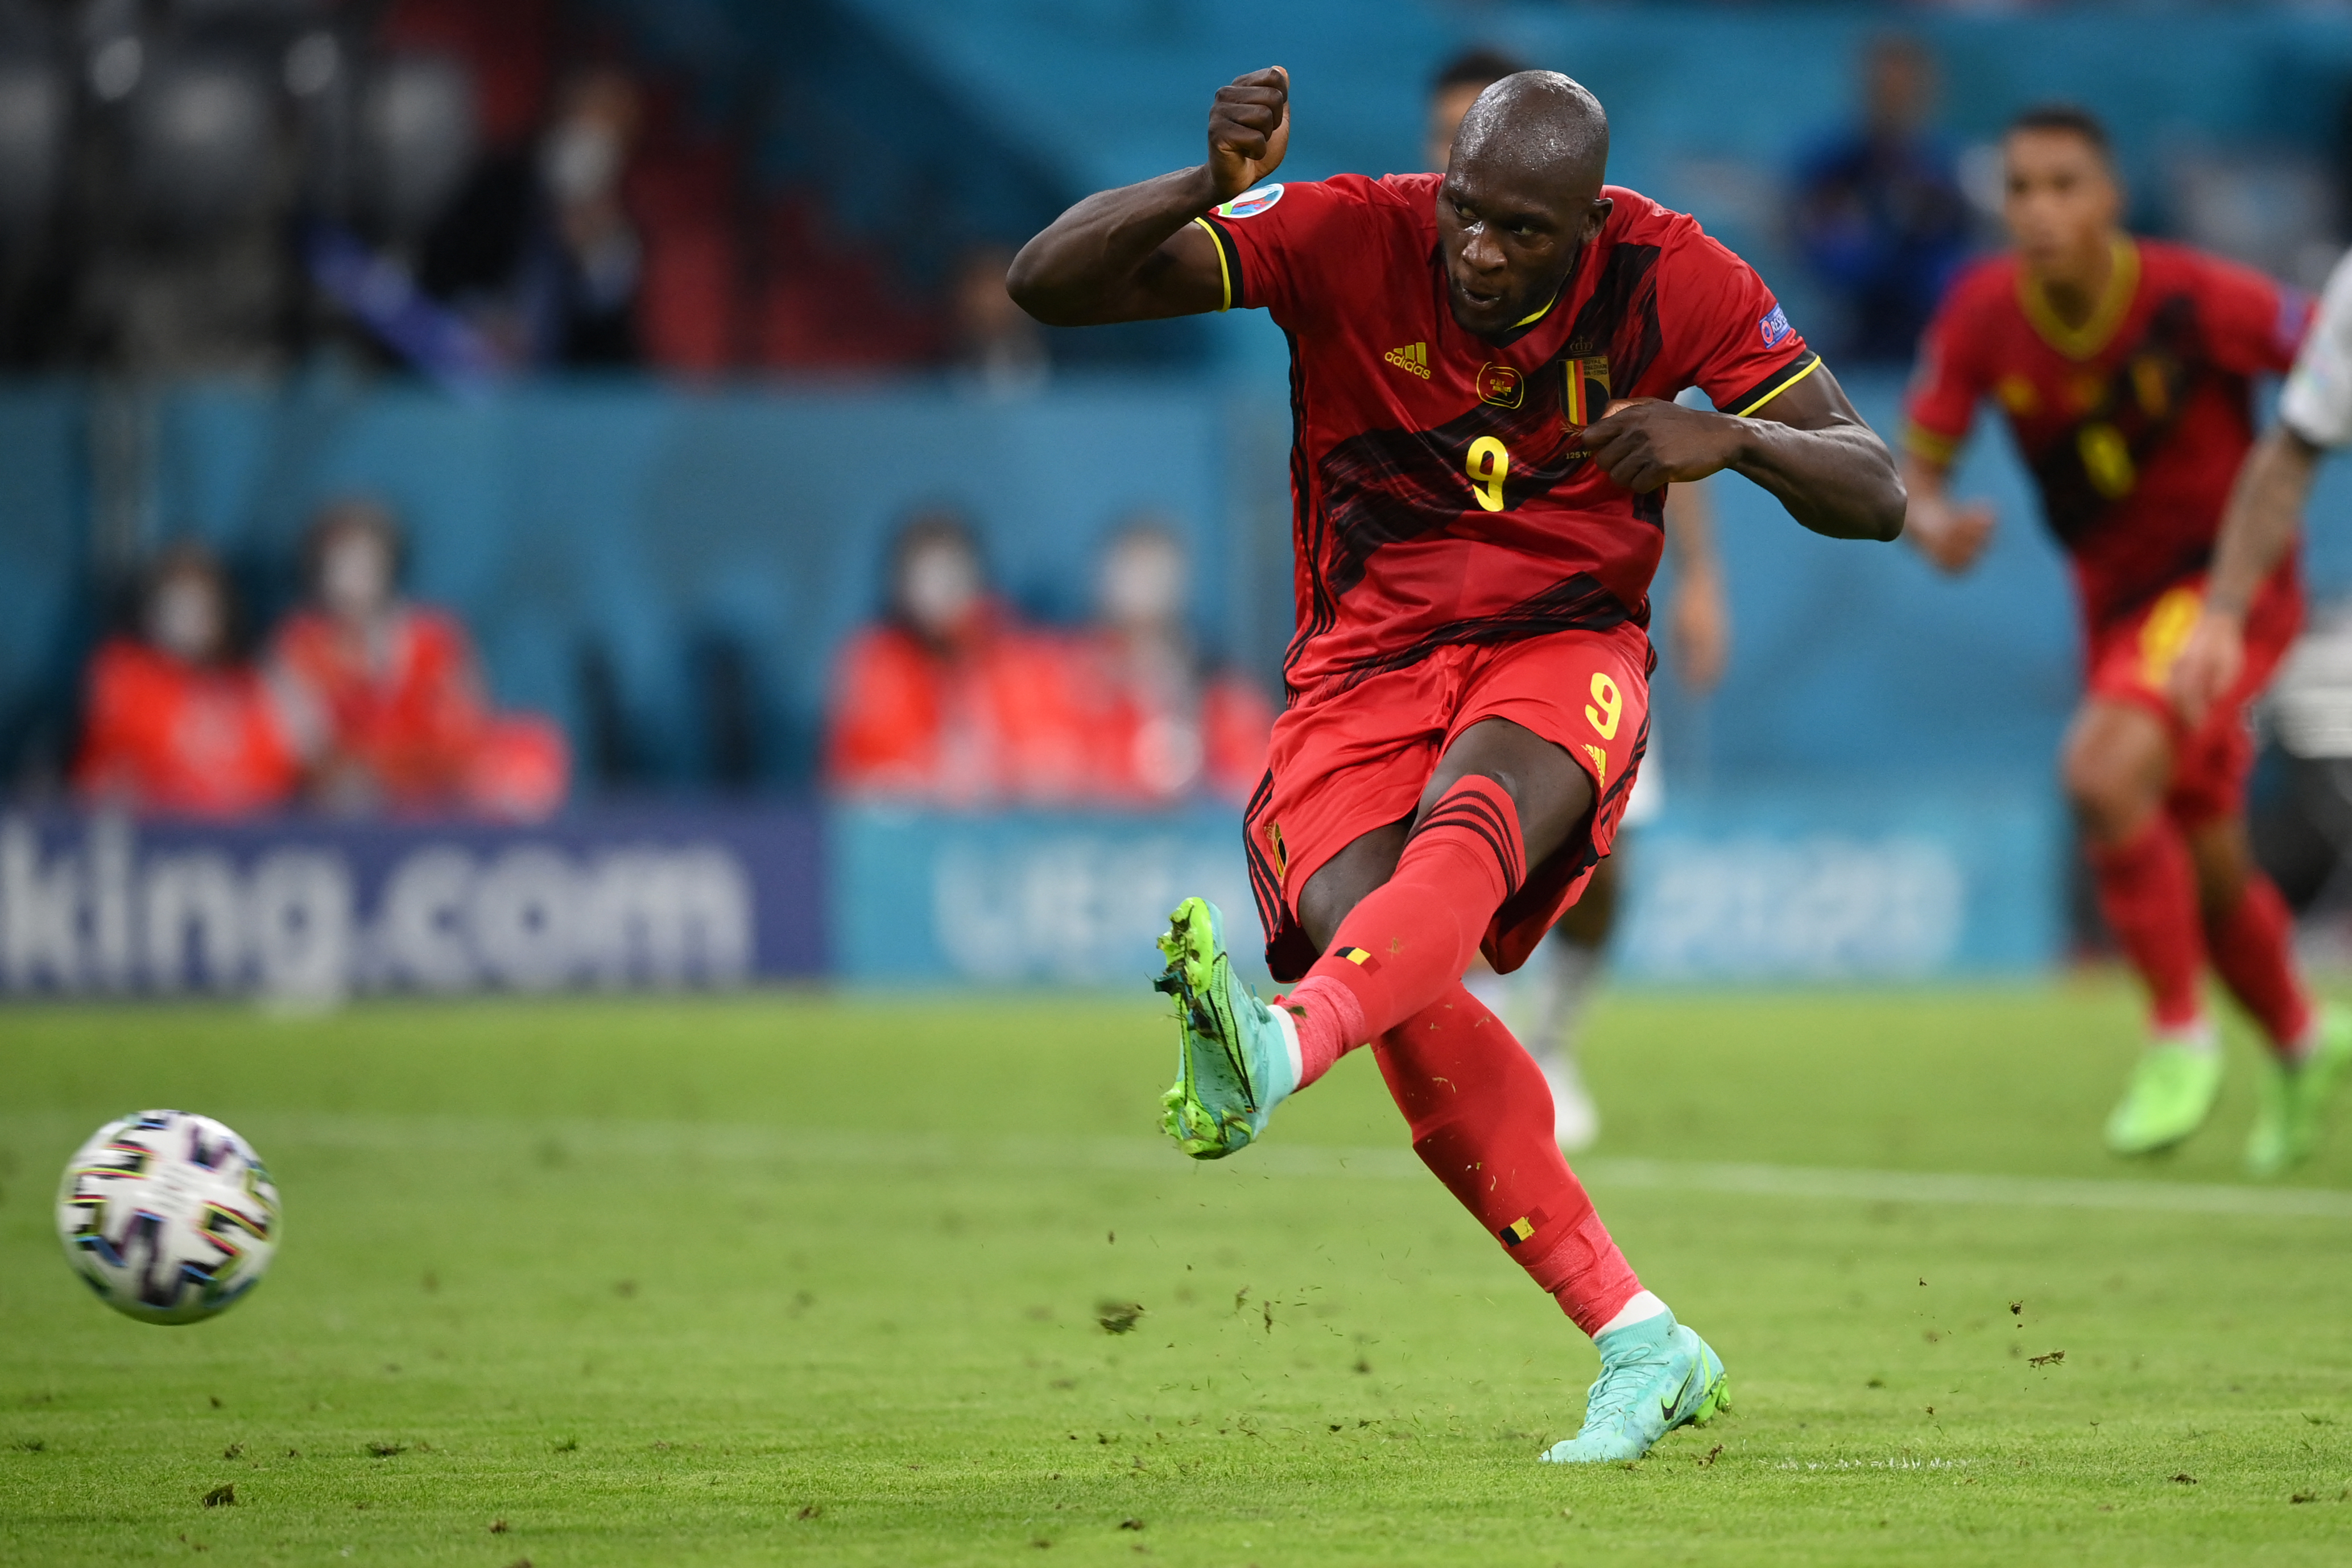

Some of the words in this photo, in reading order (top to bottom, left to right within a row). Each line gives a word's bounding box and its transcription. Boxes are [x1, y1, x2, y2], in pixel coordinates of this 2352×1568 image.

[1384, 349, 1432, 380] adidas
[1465, 435, 1509, 512] 9
[1565, 451, 1581, 460] 125
[1585, 672, 1622, 740] 9
